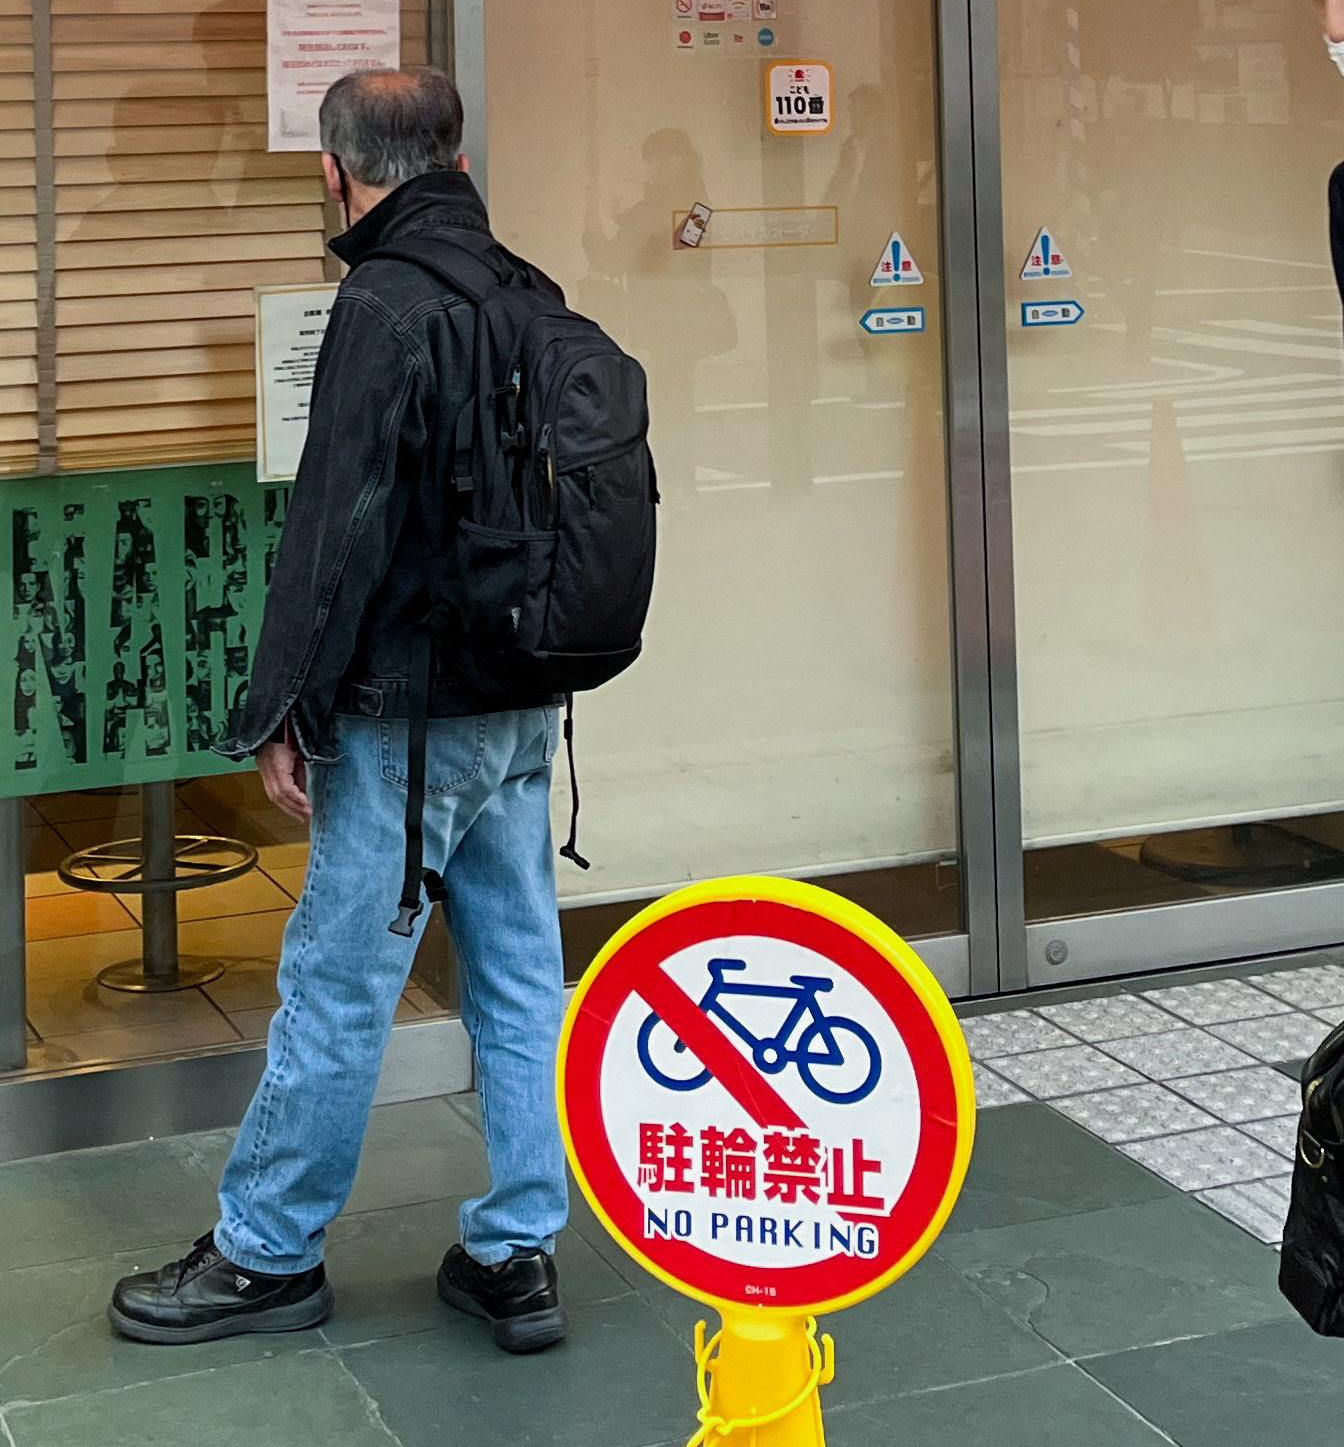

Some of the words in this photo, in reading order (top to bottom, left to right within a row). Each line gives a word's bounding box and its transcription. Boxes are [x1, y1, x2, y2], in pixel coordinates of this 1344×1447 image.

[636, 1122, 886, 1212] 駐輪禁止
[646, 1208, 694, 1239] NO
[711, 1212, 878, 1255] PARKING
